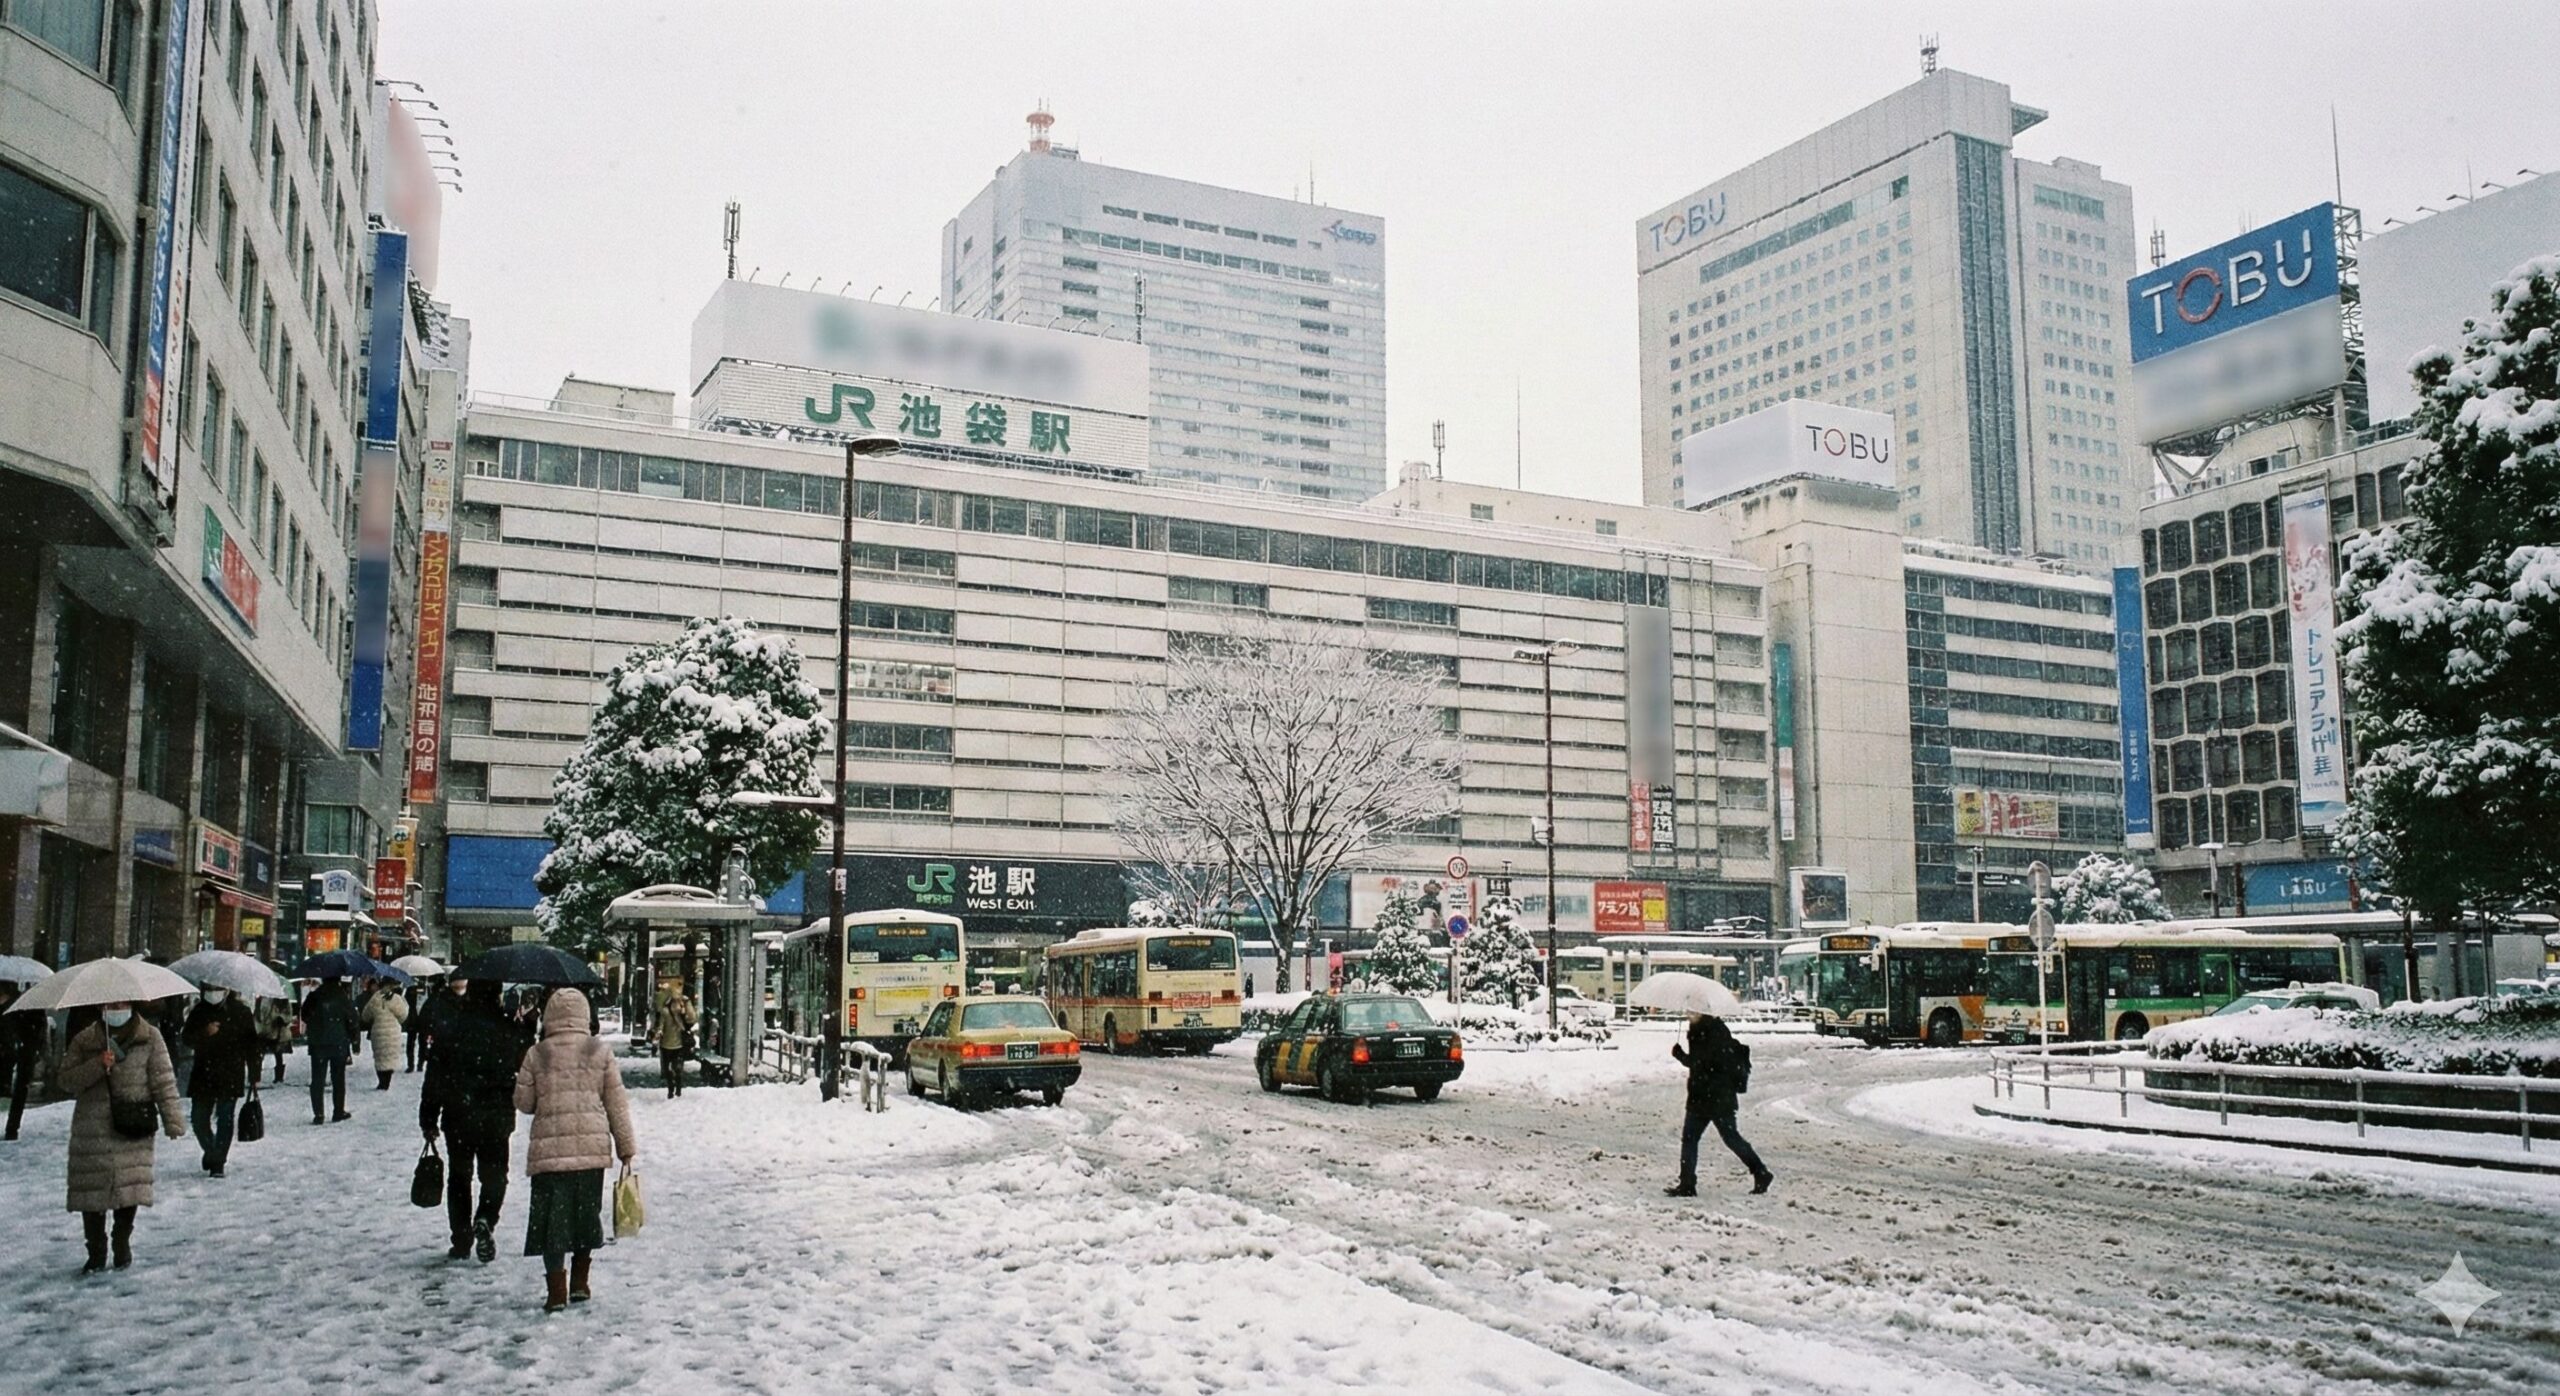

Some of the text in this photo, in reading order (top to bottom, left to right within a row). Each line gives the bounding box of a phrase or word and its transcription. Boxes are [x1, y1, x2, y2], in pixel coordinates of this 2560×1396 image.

[1649, 191, 1726, 252] TOBU
[2141, 229, 2313, 335] TOBU
[805, 383, 1072, 455] JR 池袋駅
[1805, 425, 1889, 464] TOBU
[907, 863, 1036, 896] JR 池駅
